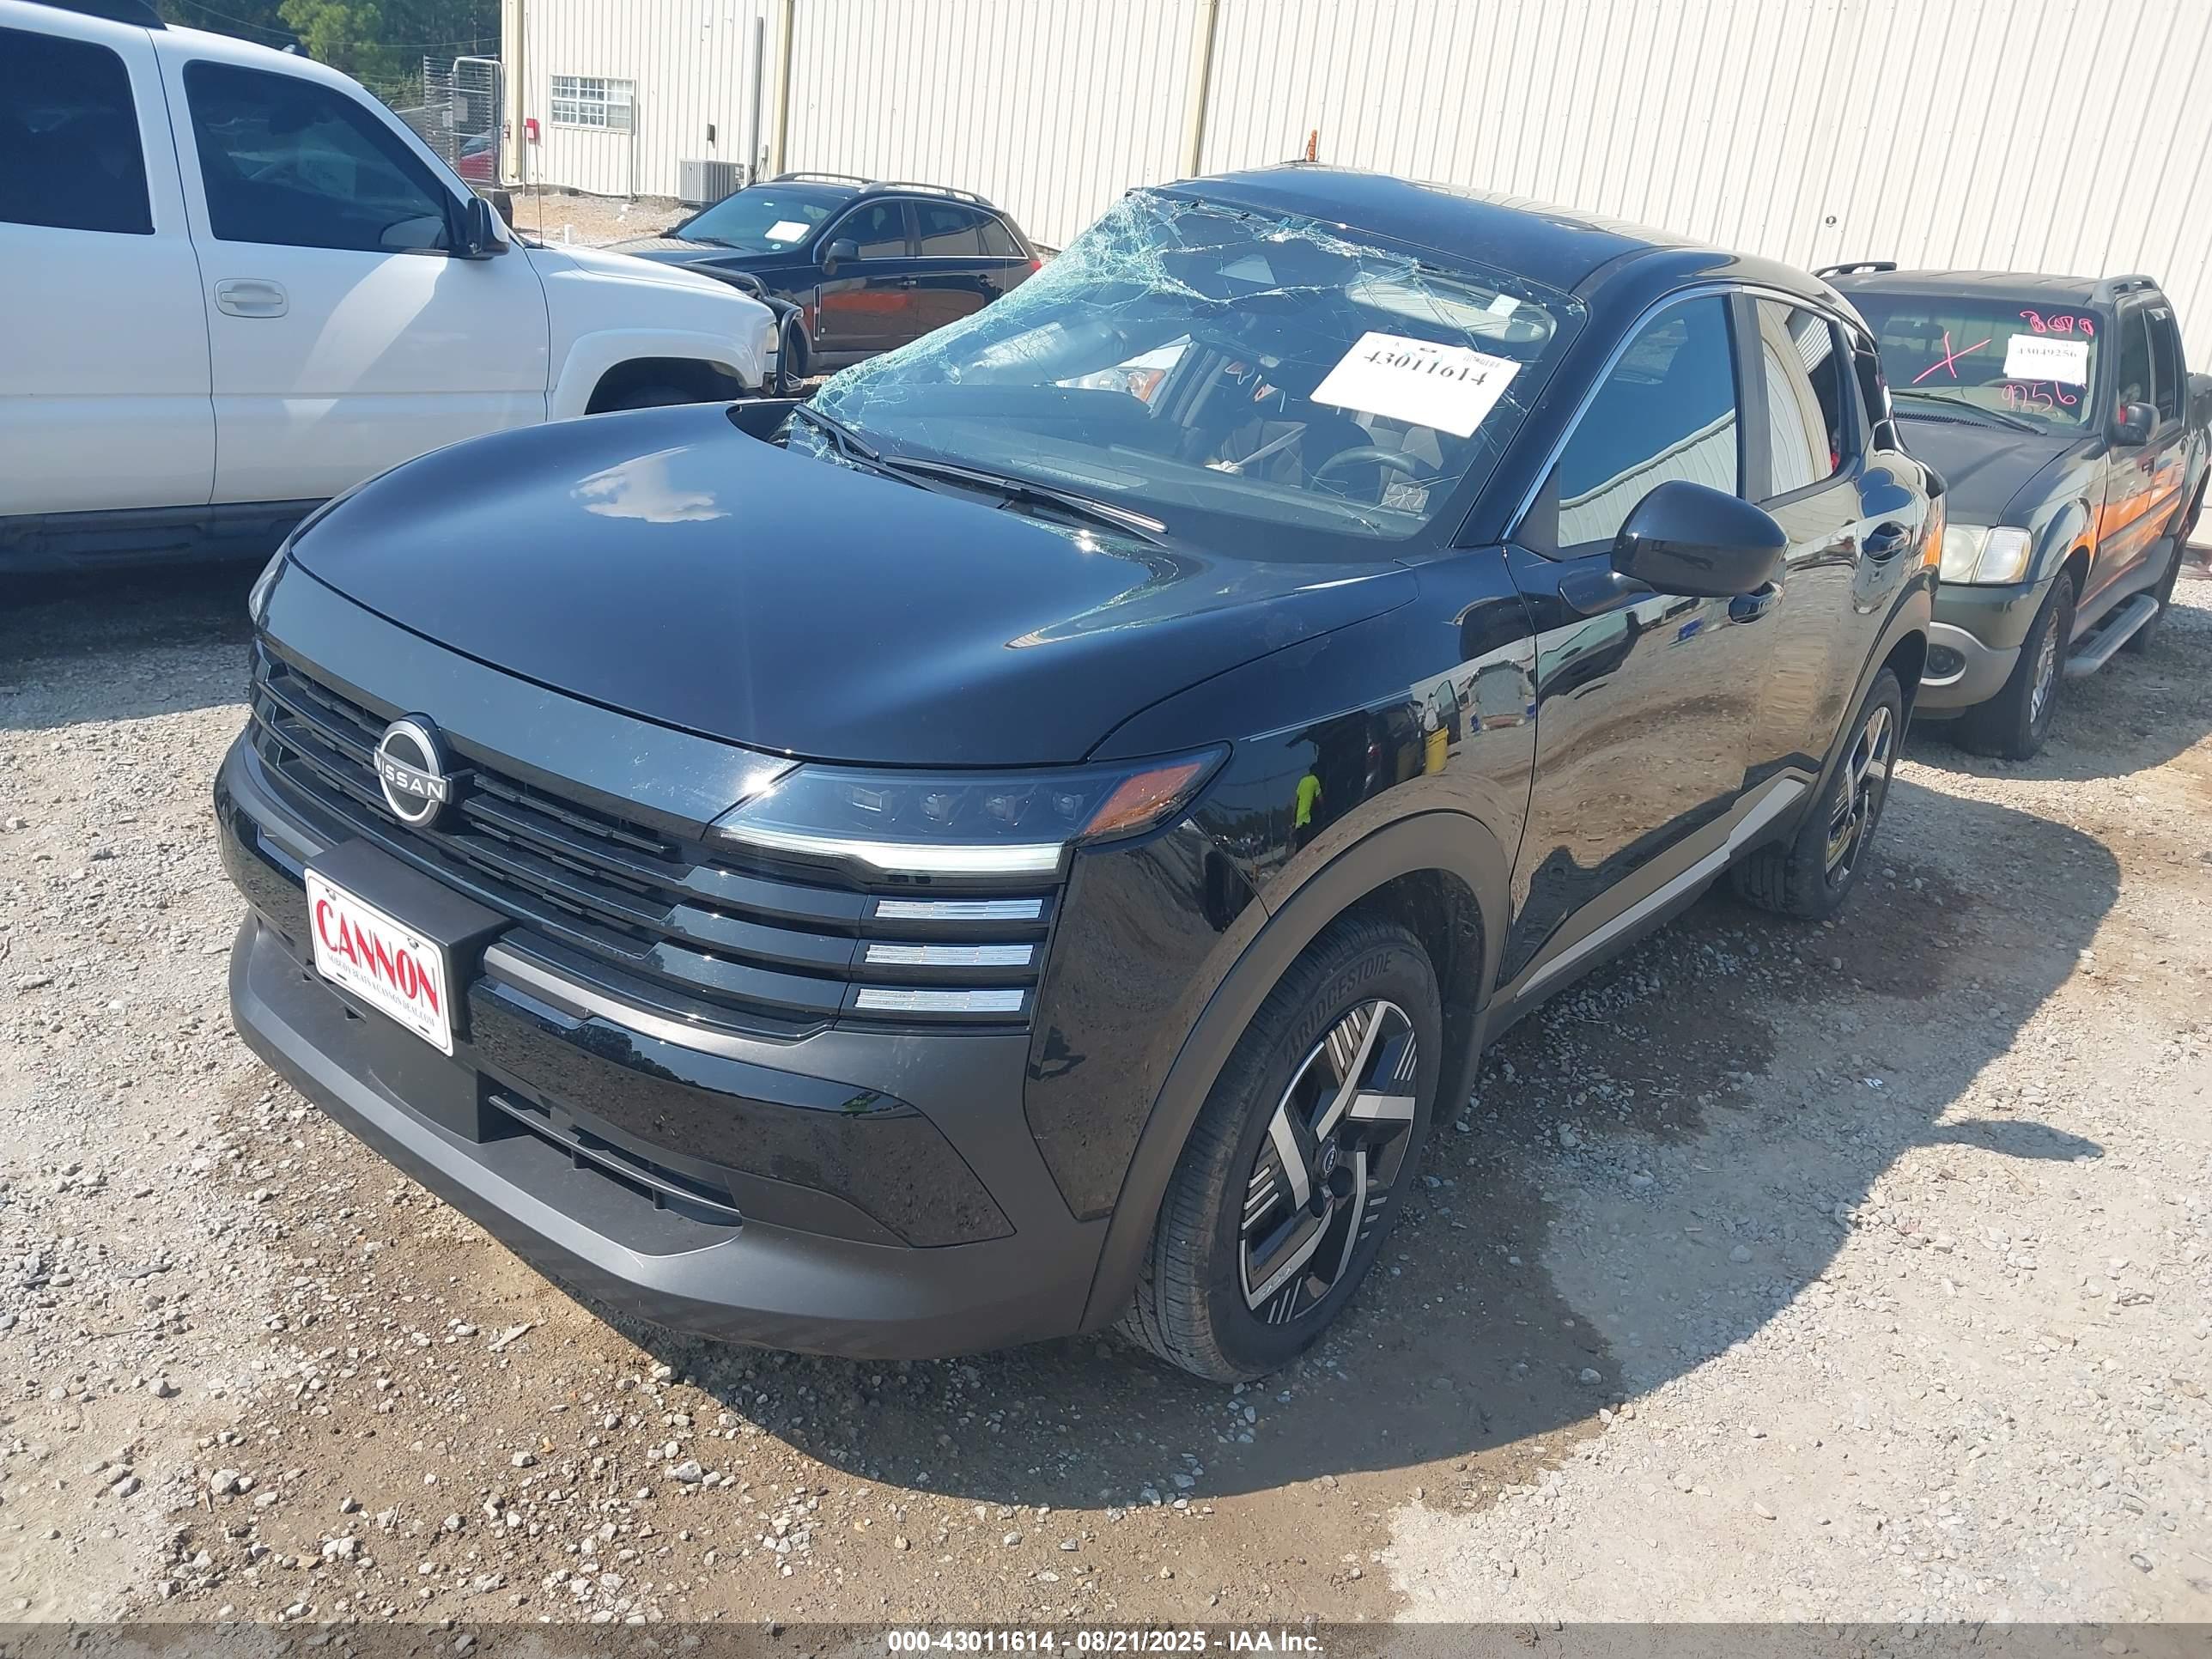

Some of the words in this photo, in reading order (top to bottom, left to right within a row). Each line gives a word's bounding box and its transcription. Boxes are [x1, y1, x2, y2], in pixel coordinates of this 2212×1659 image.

[1364, 350, 1488, 386] 43011614
[2018, 347, 2077, 358] 43049256
[2002, 380, 2077, 412] 9256
[374, 751, 443, 799] NISSAN
[316, 899, 440, 1018] CANNON
[326, 952, 351, 975] NOBODY
[352, 968, 371, 988] BEATS
[376, 984, 402, 1006] CANNON
[1285, 951, 1393, 1065] BRIDGESTONE
